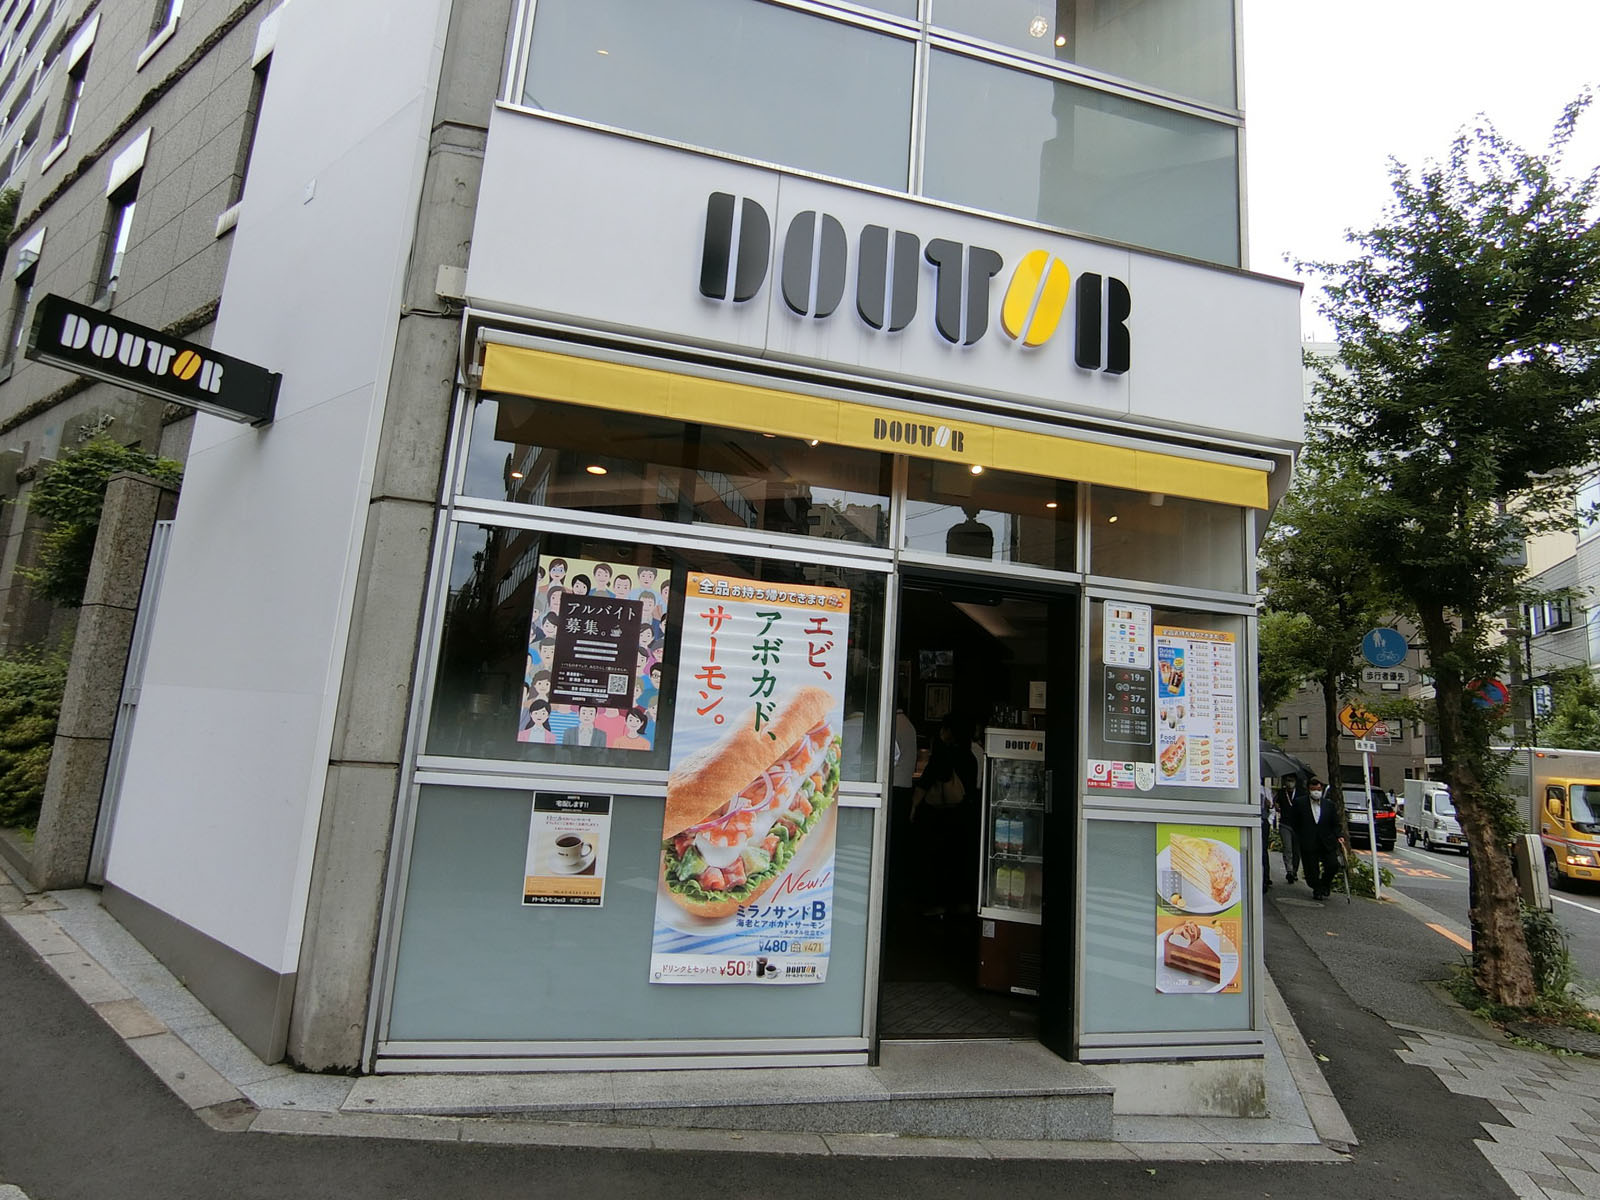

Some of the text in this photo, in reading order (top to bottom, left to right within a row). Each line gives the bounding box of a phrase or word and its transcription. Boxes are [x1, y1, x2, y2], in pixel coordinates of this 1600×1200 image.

[699, 191, 1131, 374] DOUTOR
[60, 313, 224, 394] DOUTOR
[873, 417, 965, 453] DOUTOR
[699, 577, 827, 606] 全品お持ち帰りできます
[566, 601, 637, 621] アルバイト
[565, 617, 607, 637] 募集。
[803, 616, 834, 681] エビ、
[694, 604, 733, 725] サーモン。
[749, 611, 784, 741] アボカド、
[1366, 671, 1406, 682] 歩行者優先
[1005, 739, 1044, 752] DOUTOR
[771, 869, 831, 904] New!
[735, 900, 826, 922] ミラノサンドB
[759, 940, 788, 953] ¥480
[719, 960, 746, 977] ¥50
[785, 965, 817, 974] DOUTOR
